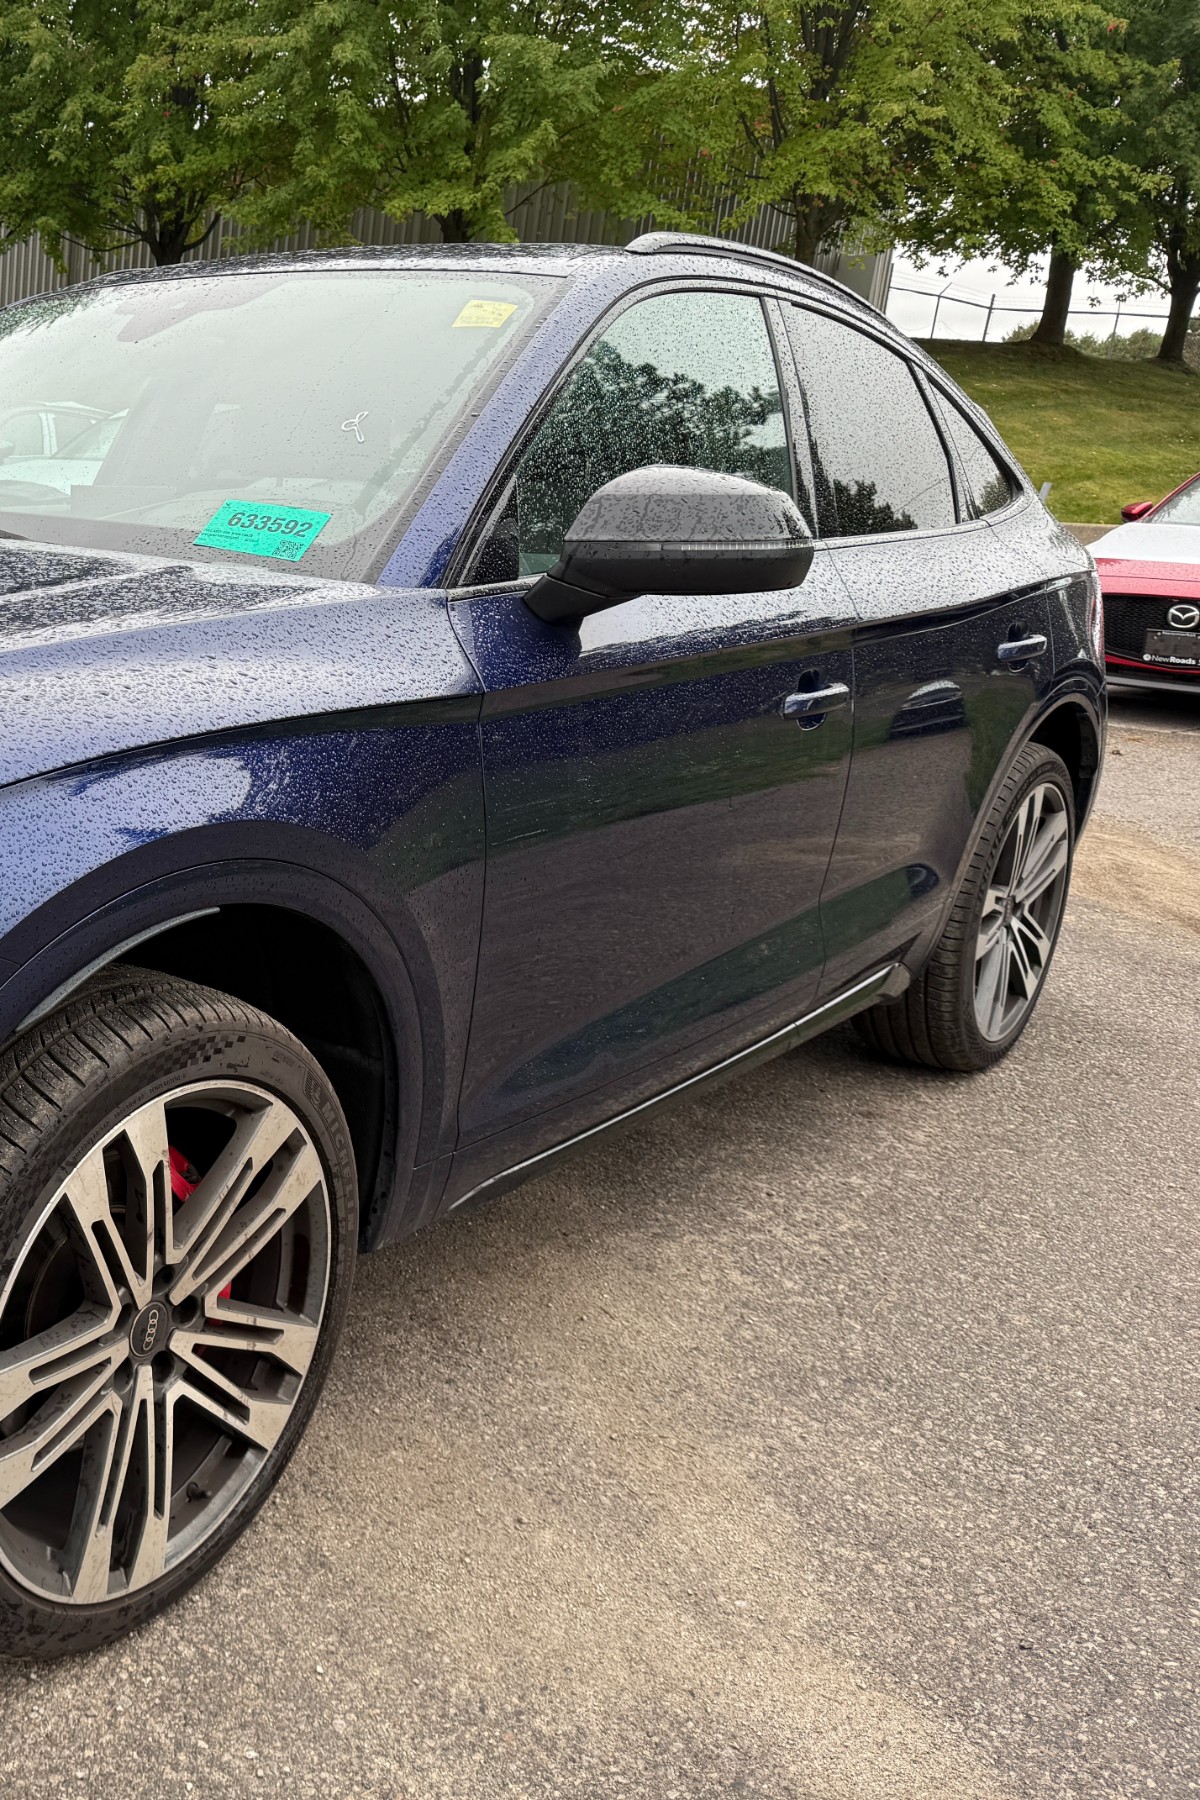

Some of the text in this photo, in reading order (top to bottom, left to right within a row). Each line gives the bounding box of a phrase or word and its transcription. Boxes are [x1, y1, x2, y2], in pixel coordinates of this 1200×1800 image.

[227, 512, 313, 538] 633592
[1151, 654, 1196, 665] NewRoads
[321, 1101, 355, 1231] MICHELIN
